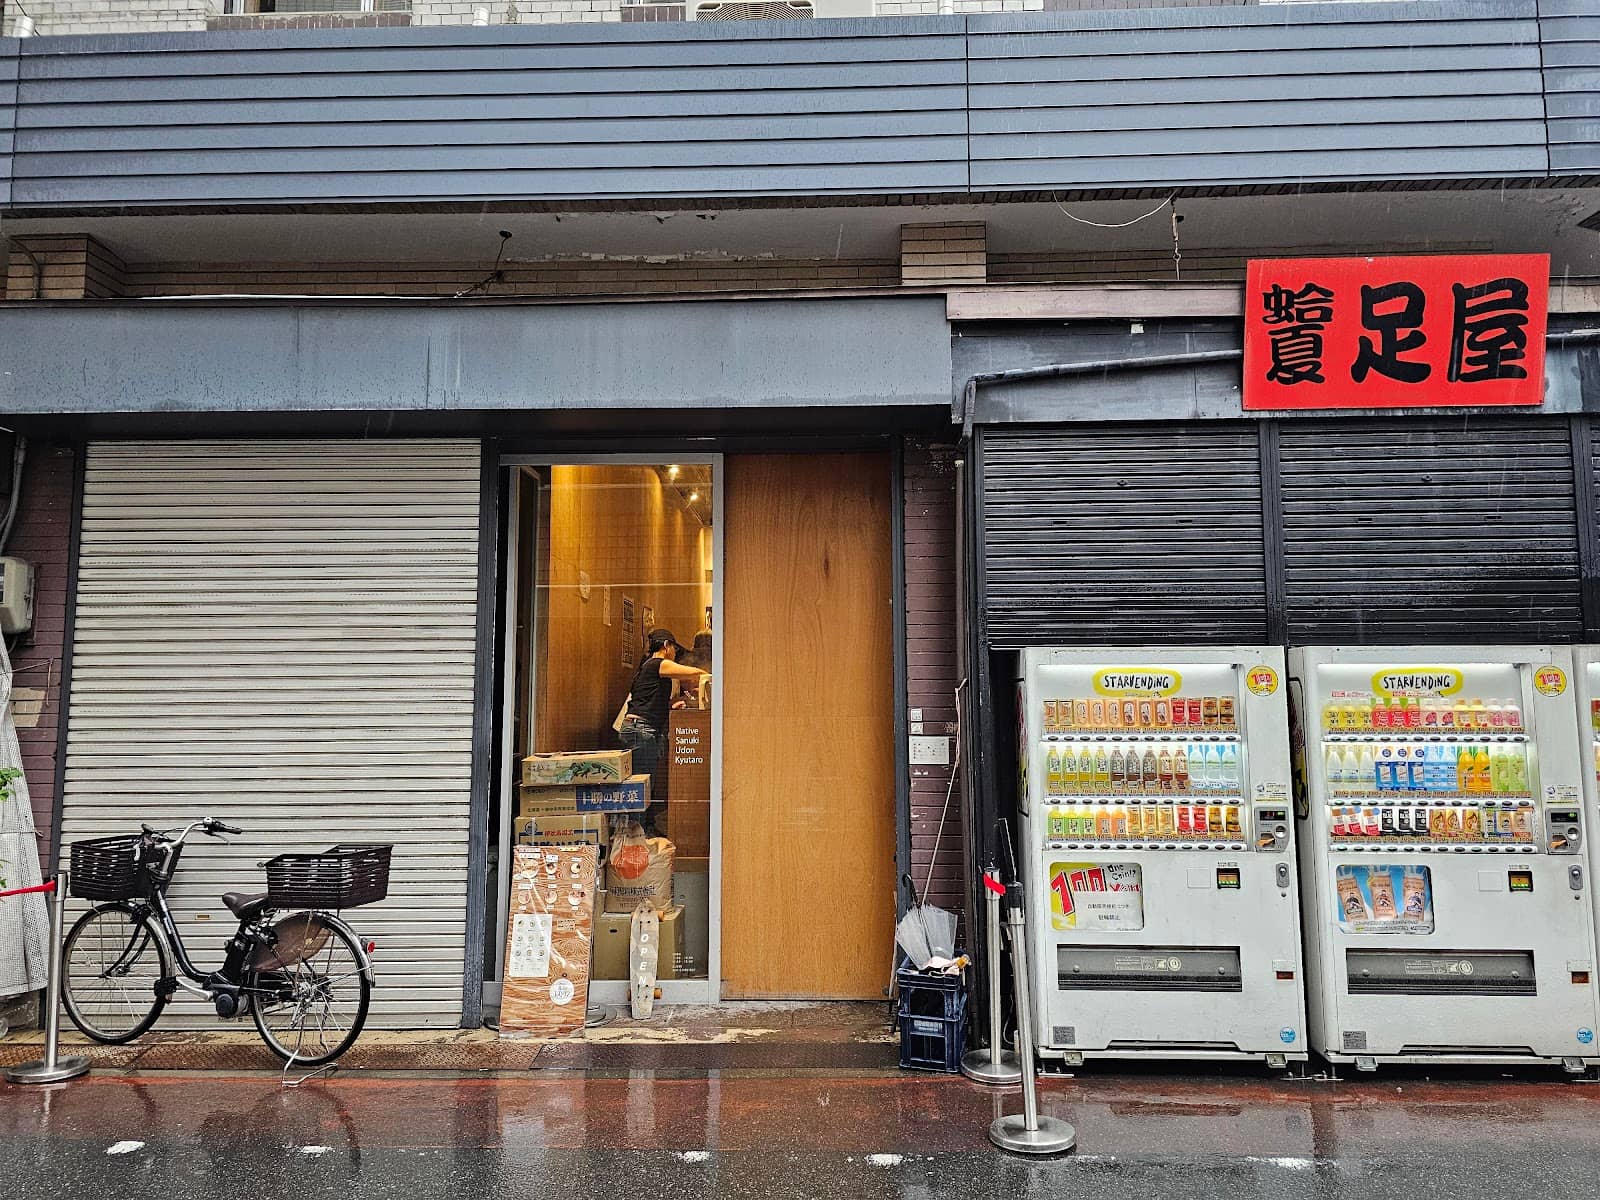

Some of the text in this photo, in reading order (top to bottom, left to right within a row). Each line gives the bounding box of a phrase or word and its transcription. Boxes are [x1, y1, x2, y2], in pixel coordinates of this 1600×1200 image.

[675, 727, 699, 735] Native
[675, 737, 700, 745] Sanuki
[675, 746, 695, 754] Udon
[675, 756, 703, 765] Kyutaro
[639, 933, 649, 986] OPEN
